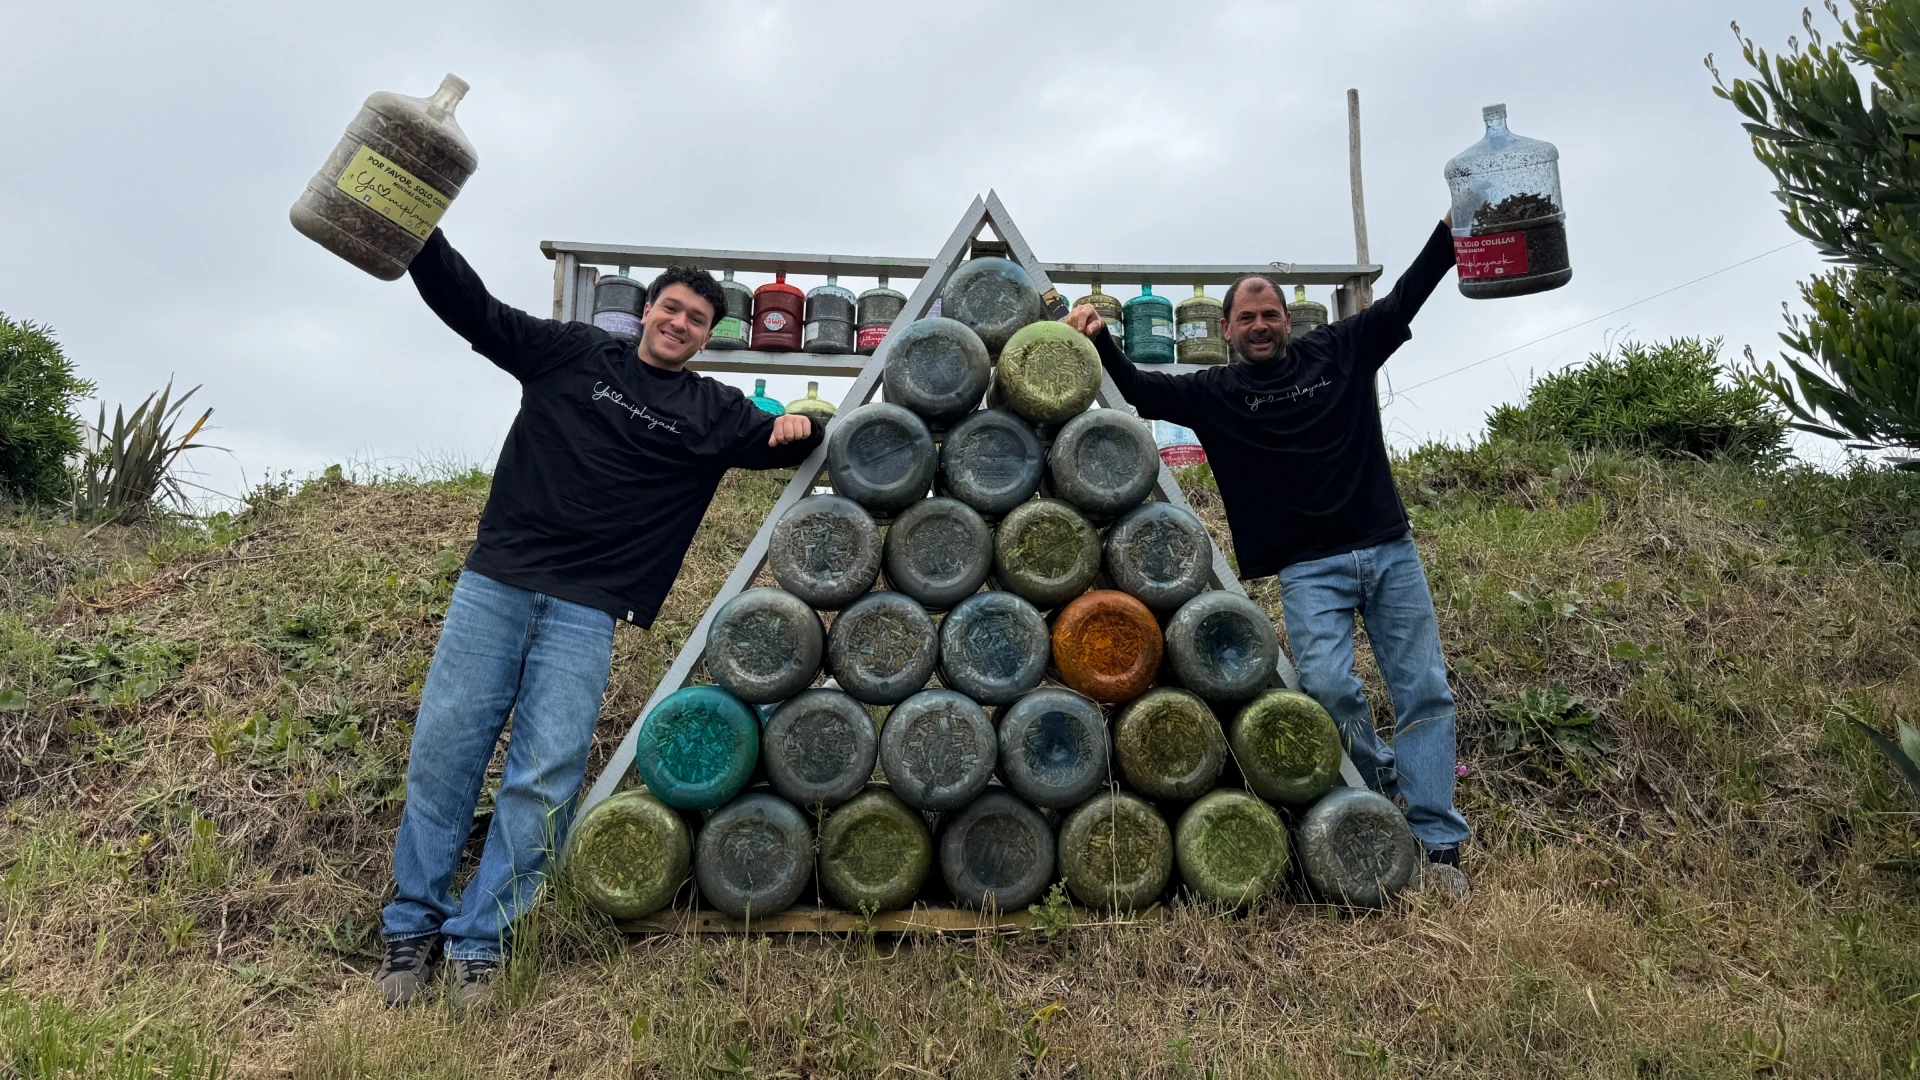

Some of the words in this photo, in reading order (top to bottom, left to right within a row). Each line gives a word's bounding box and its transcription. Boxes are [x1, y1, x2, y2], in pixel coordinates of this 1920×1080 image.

[367, 156, 385, 170] POR
[384, 166, 412, 189] FAVOR,
[414, 185, 433, 200] SOLO
[392, 182, 414, 198] MUCHAS
[1464, 240, 1480, 248] SOLO
[1481, 236, 1516, 247] COLILLAS
